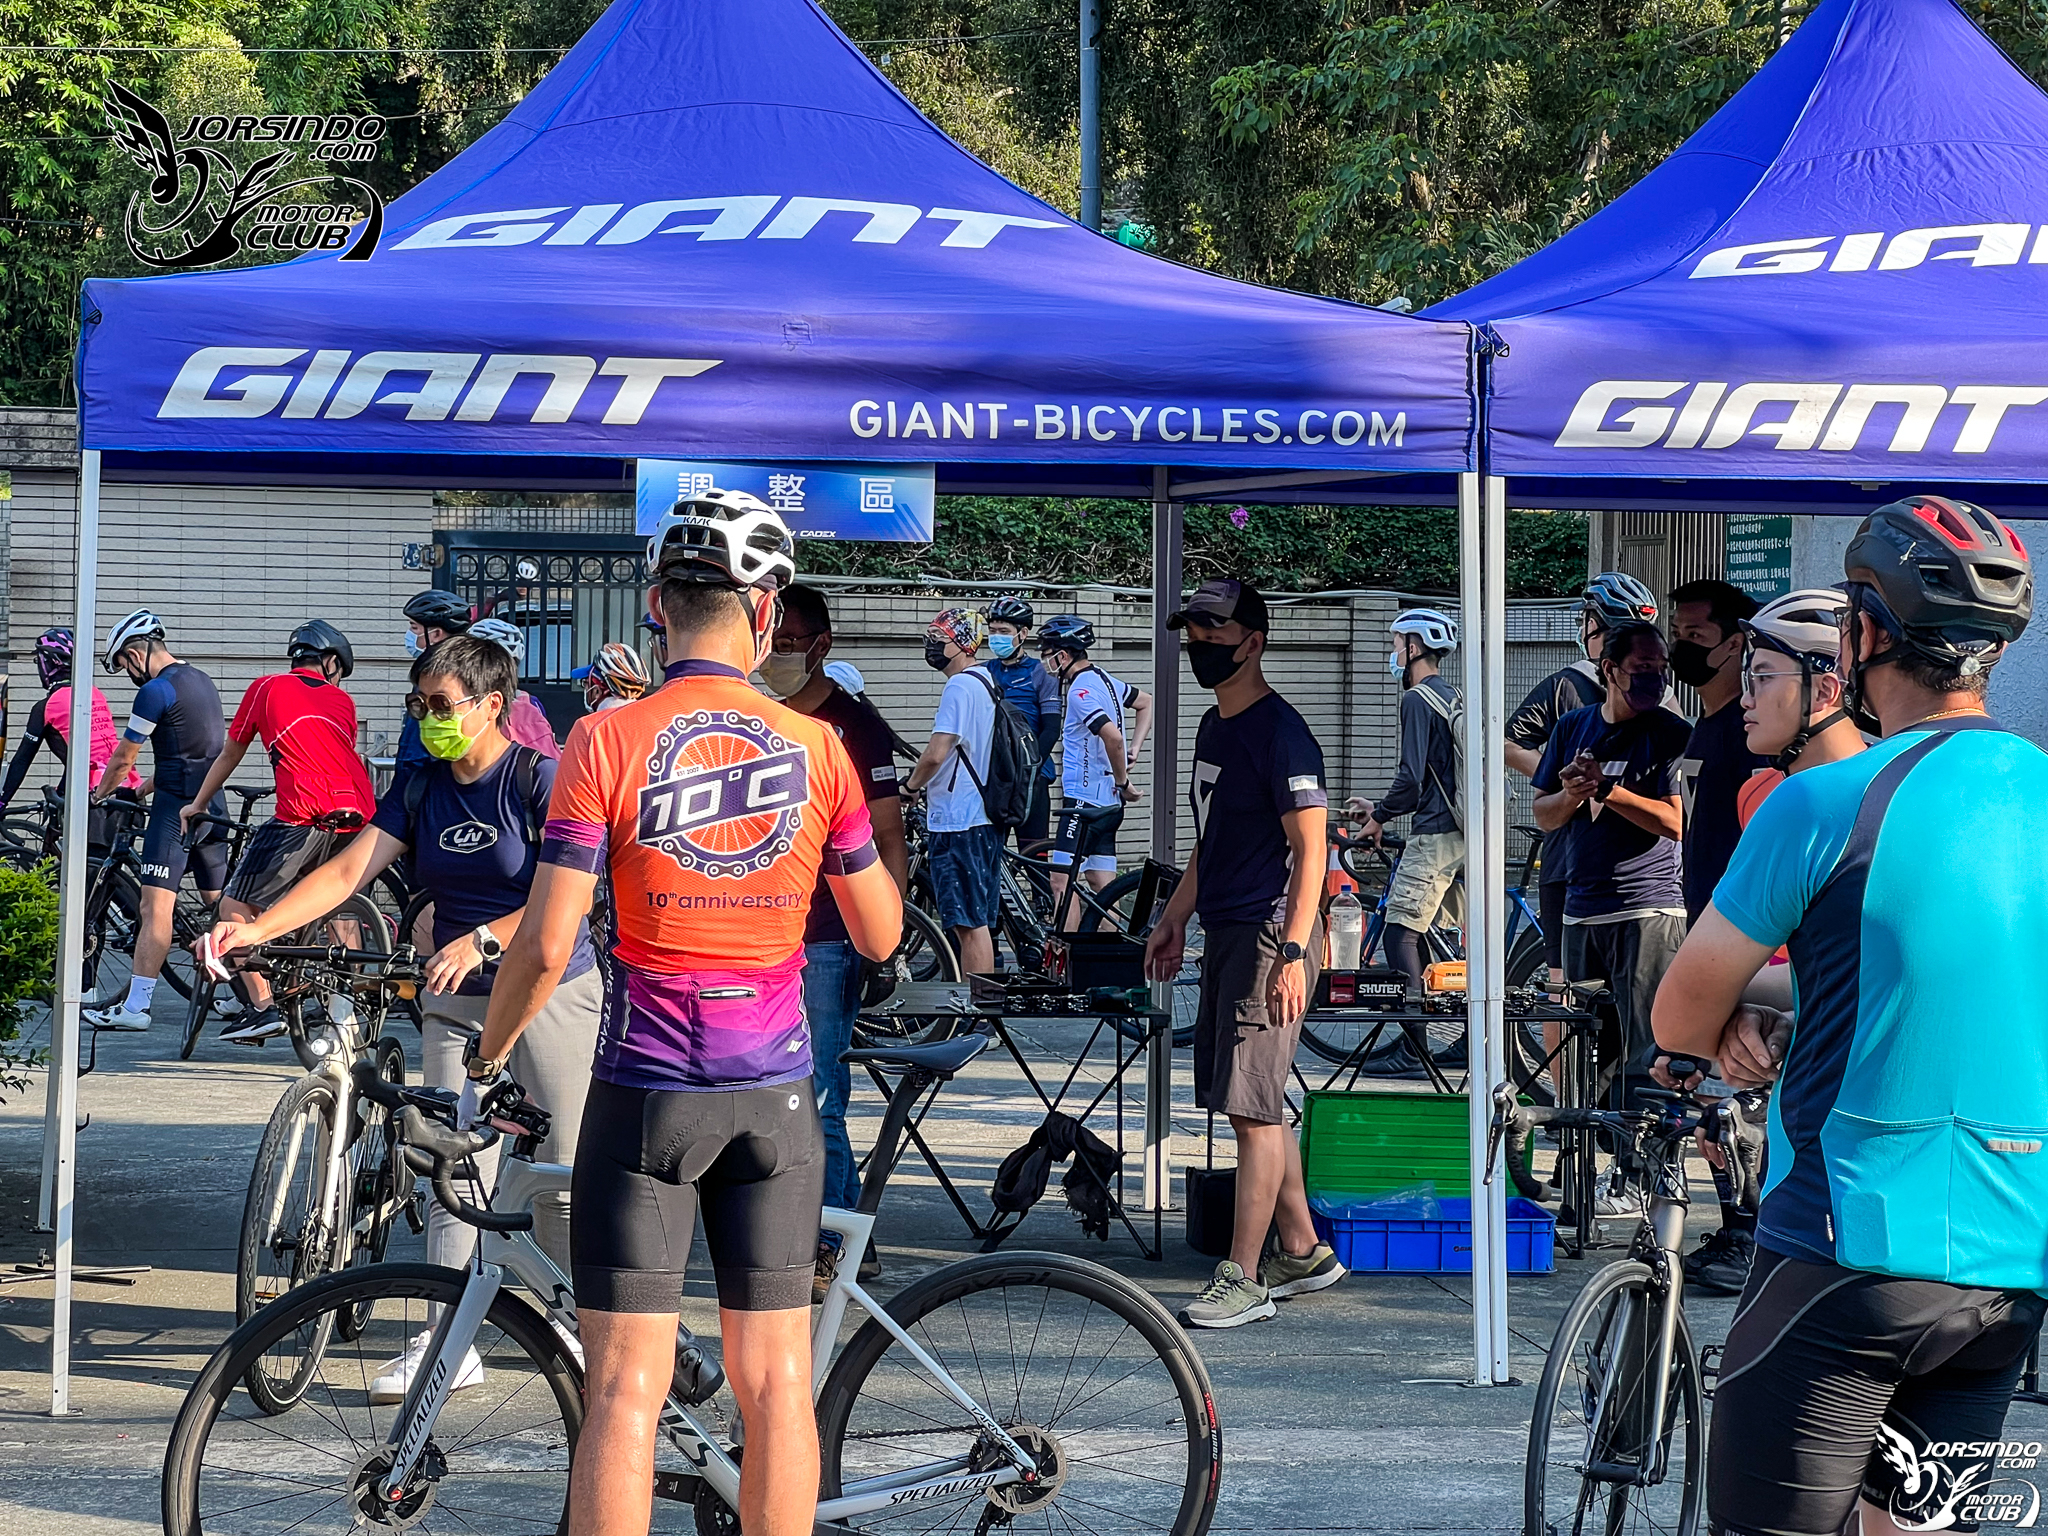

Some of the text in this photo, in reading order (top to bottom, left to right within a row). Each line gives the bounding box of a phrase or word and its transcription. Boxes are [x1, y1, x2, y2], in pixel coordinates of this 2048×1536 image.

[390, 195, 1071, 252] GIANT
[156, 345, 723, 425] GIANT
[849, 399, 1407, 448] GIANT-BICYCLES.COM
[1553, 380, 2048, 454] GIANT
[683, 516, 712, 527] KASK
[799, 529, 837, 539] CADEX
[453, 827, 483, 844] Liv
[678, 891, 804, 909] anniversary
[1358, 982, 1403, 994] SHUTER
[396, 1358, 447, 1476] SPECIALIZED
[970, 1403, 1022, 1456] TARMAC
[1211, 1429, 1219, 1461] TURBO
[886, 1473, 998, 1507] SPECIALIZED
